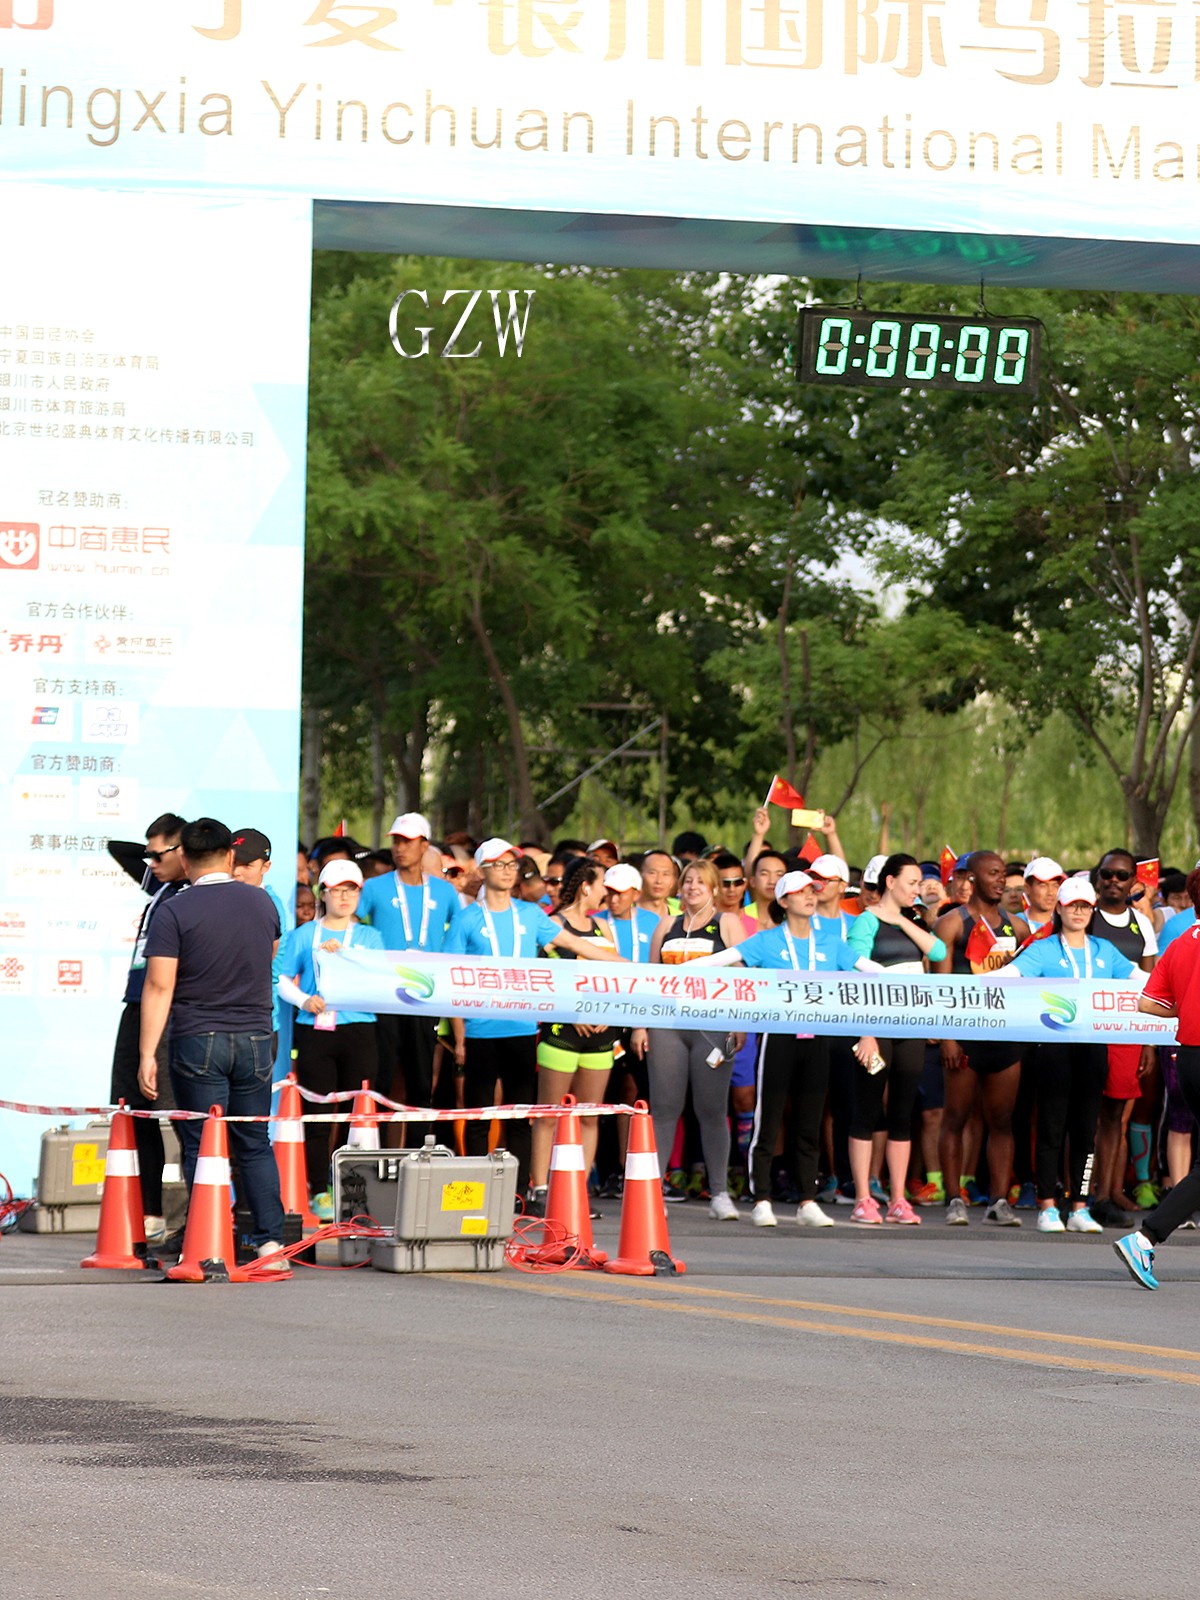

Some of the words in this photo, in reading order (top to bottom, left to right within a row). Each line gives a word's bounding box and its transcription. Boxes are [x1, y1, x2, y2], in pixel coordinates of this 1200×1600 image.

[0, 68, 233, 147] ingxia
[261, 80, 595, 155] Yinchuan
[627, 99, 1064, 177] International
[815, 318, 1030, 384] 0:00:00
[47, 524, 171, 555] 中商惠民
[9, 633, 64, 655] 乔丹
[450, 965, 555, 993] 中商惠民
[574, 974, 640, 995] 2017
[777, 980, 1007, 1011] 宁夏·银川国际马拉松
[1091, 990, 1139, 1014] 中商
[450, 996, 555, 1013] www.huimin.cn
[575, 1001, 610, 1014] 2017
[650, 1004, 677, 1017] Silk
[728, 1008, 780, 1024] Ningxia
[783, 1009, 849, 1024] Yinchuan
[852, 1012, 939, 1027] International
[941, 1013, 1007, 1029] Marathon
[1092, 1018, 1177, 1033] www.huimin.
